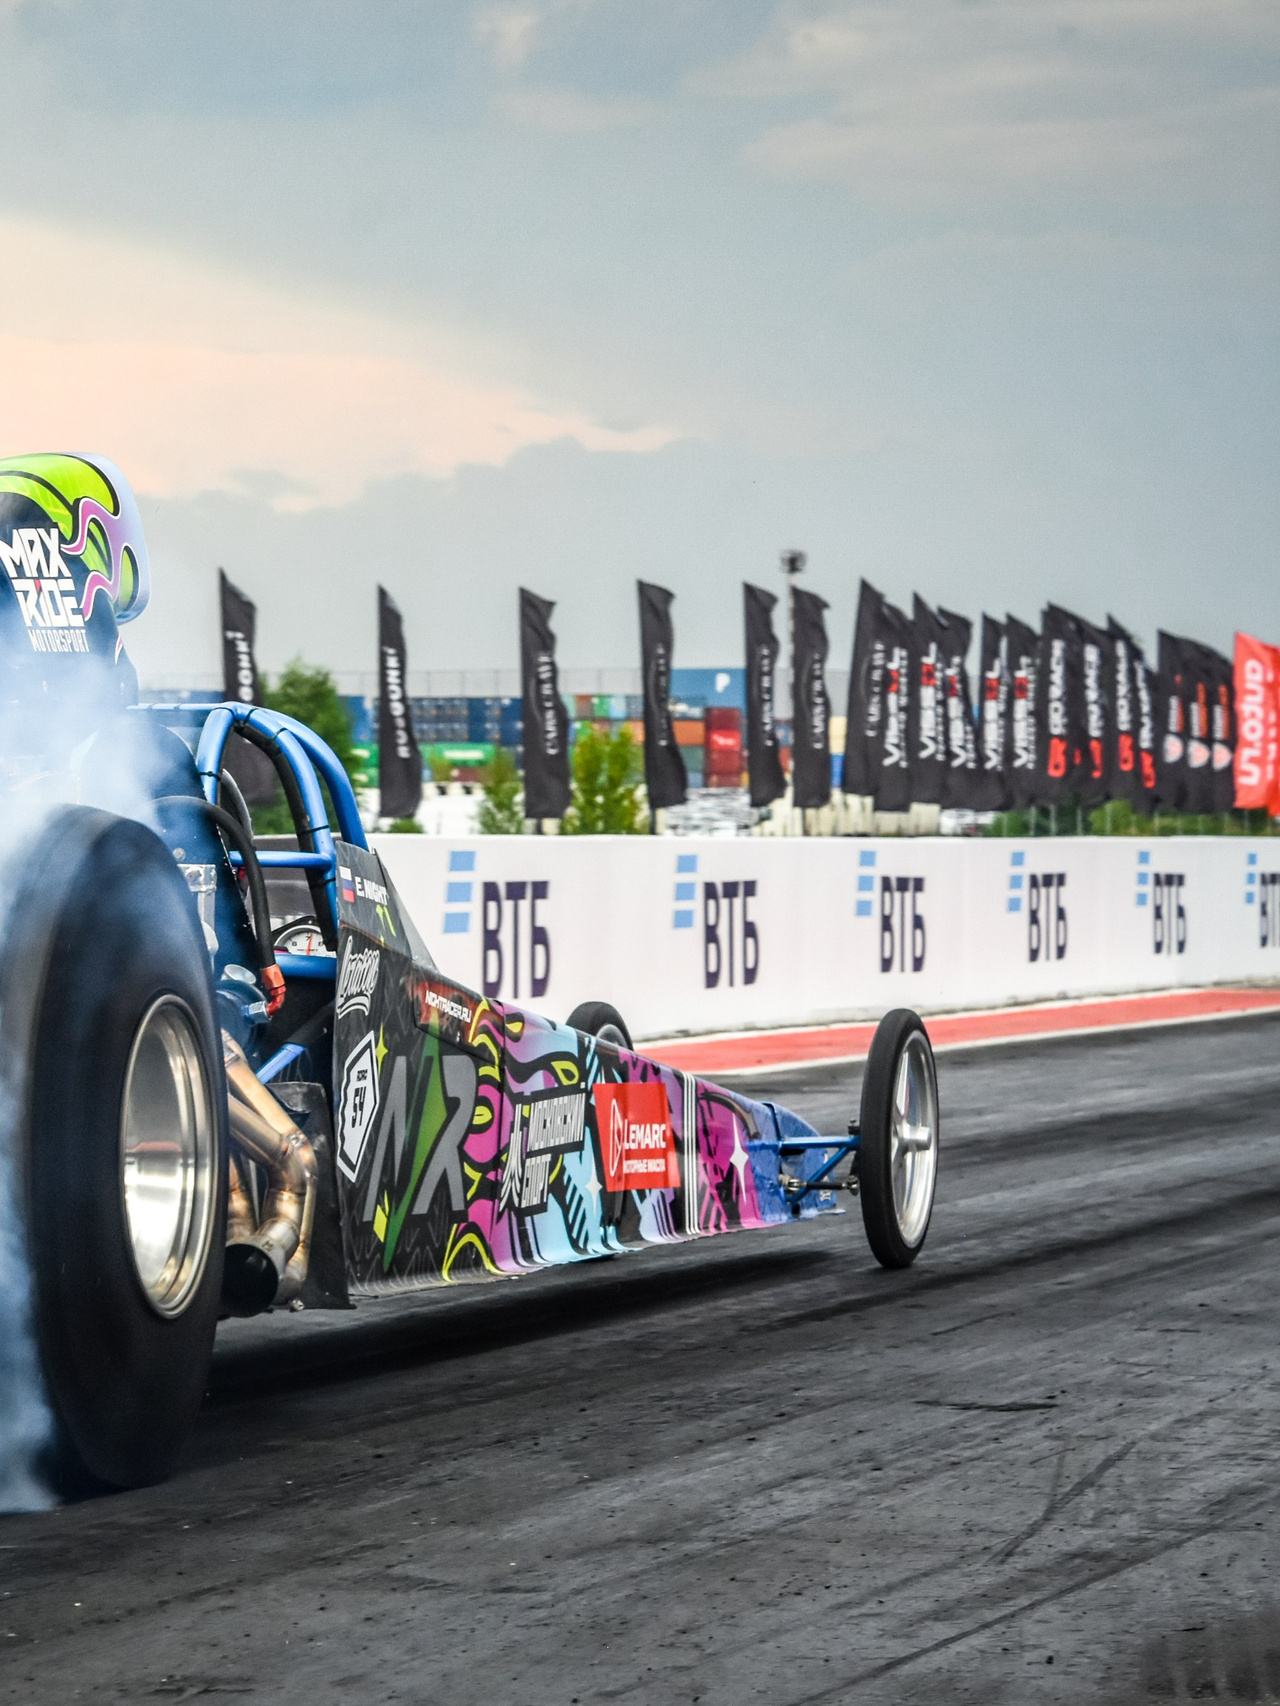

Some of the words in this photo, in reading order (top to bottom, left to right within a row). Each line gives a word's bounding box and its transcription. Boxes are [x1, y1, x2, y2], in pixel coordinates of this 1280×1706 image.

[12, 578, 85, 627] RIDE
[28, 629, 90, 653] MOTORSPORT
[482, 881, 550, 998] ВТБ
[704, 880, 759, 989] ВТБ
[881, 876, 926, 973] ВТБ
[1029, 873, 1067, 962] ВТБ
[1153, 872, 1187, 954] ВТБ
[1260, 872, 1280, 947] ВТ
[351, 1086, 367, 1129] 54
[624, 1119, 666, 1150] LEMARC
[521, 1153, 551, 1209] СПОРТ
